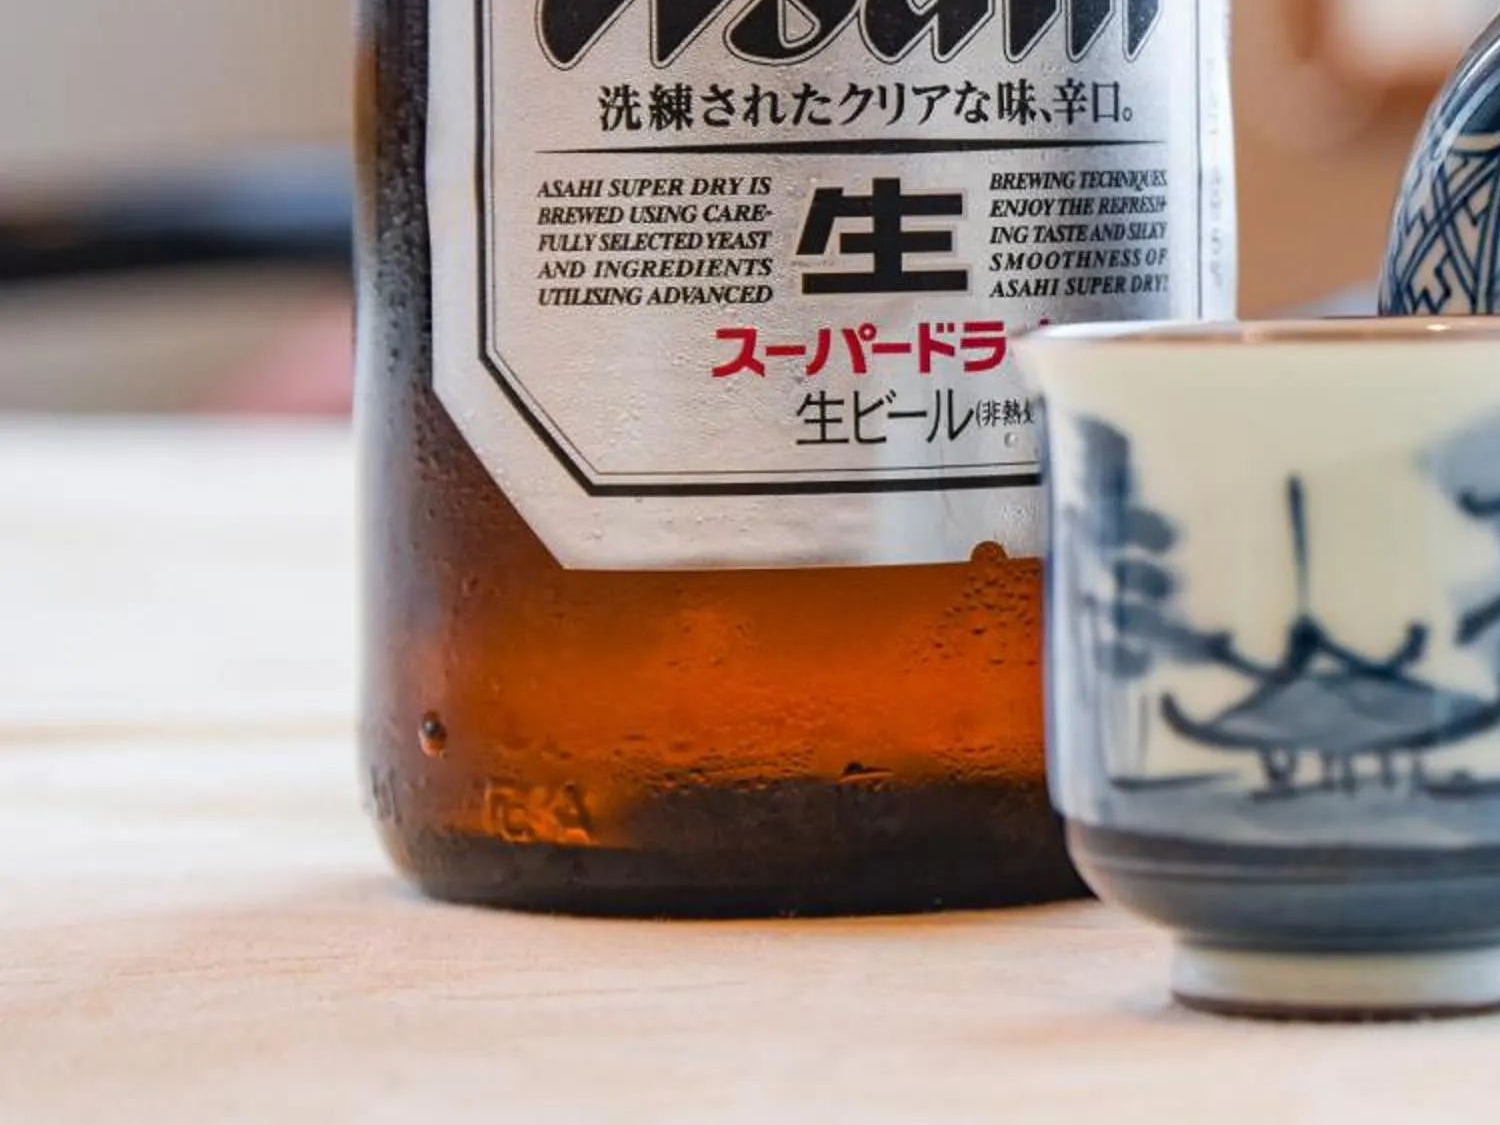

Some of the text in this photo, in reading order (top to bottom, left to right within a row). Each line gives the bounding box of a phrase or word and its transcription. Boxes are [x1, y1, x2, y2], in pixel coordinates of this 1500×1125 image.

[597, 78, 1133, 132] 洗練されたクリアな味、辛口。
[537, 176, 772, 198] ASAHI SUPER DRY IS
[989, 169, 1076, 191] BREWING
[537, 204, 773, 225] BREWED USING CARE-
[989, 197, 1057, 217] ENJOY
[1058, 197, 1095, 216] THE
[537, 230, 773, 252] FULLY SELECTED YEAST
[795, 177, 968, 295] 生
[989, 221, 1168, 244] ING TASTE AND SILKY
[537, 258, 773, 279] AND INGREDIENTS
[989, 247, 1168, 272] SMOOTHNESS OF
[538, 284, 773, 306] UTILISING ADVANCED
[989, 278, 1061, 298] ASAHI
[1064, 275, 1127, 296] SUPER
[711, 318, 1049, 377] スーパードラ
